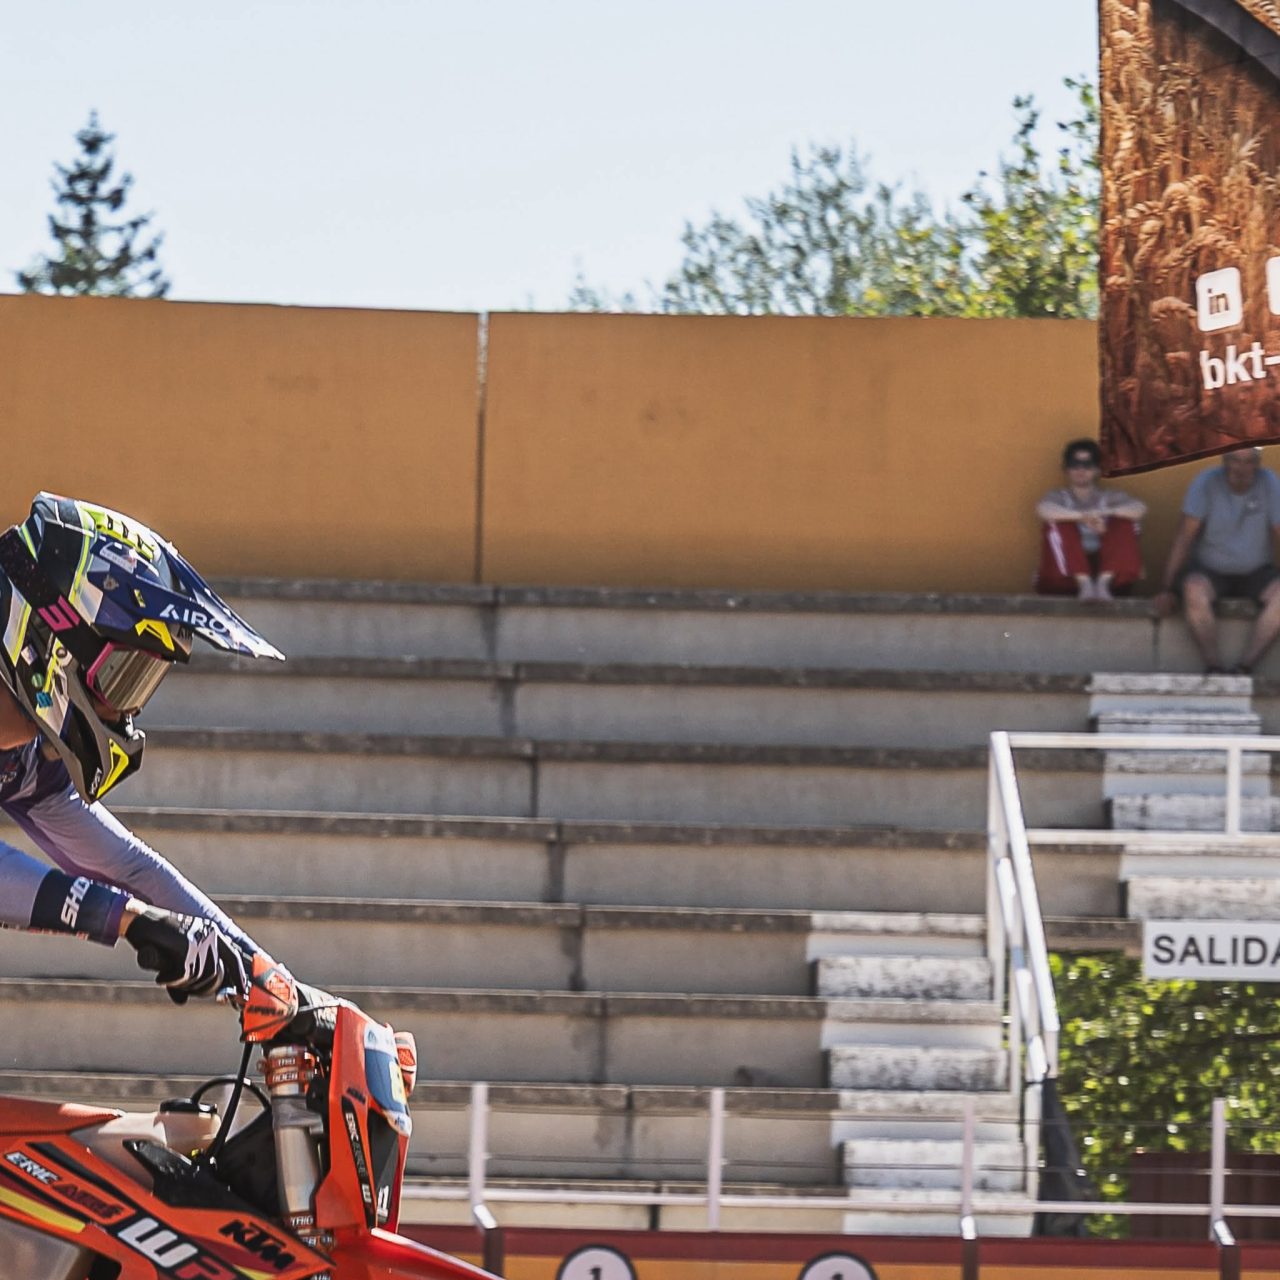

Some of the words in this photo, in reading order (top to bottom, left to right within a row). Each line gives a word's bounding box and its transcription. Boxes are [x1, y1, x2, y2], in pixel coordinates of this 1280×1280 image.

[1206, 288, 1230, 315] in
[160, 603, 237, 638] AIRO
[60, 875, 93, 929] SHO
[218, 1219, 297, 1270] KTM
